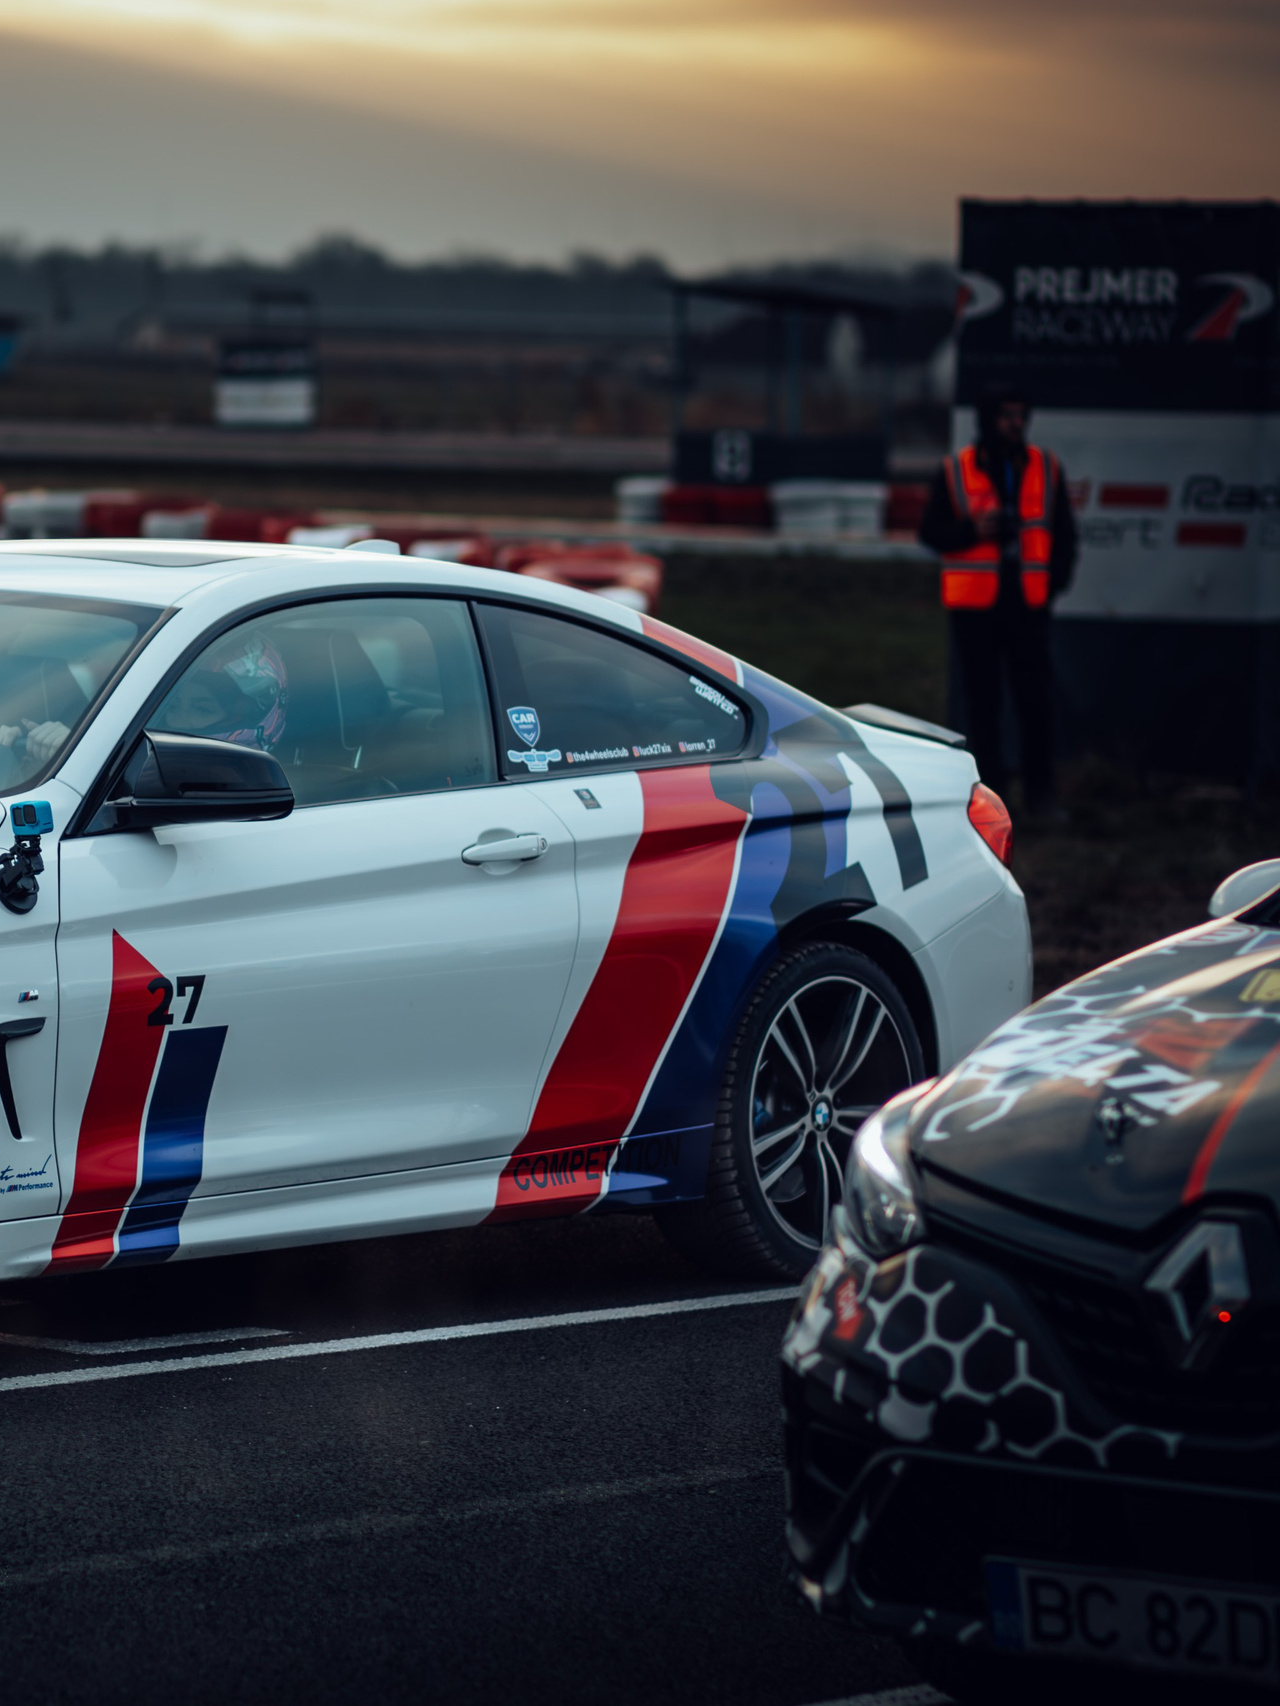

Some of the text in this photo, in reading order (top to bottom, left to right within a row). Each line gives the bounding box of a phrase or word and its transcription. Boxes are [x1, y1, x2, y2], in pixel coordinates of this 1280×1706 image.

[1014, 266, 1179, 304] PREJMER
[1012, 308, 1177, 343] RACEWAY
[511, 713, 536, 724] CAR
[572, 747, 629, 762] the4wheelsclub
[638, 743, 672, 756] luck27xix
[147, 974, 206, 1027] 27
[19, 1182, 54, 1191] Performance
[1029, 1577, 1280, 1669] BC 82D
